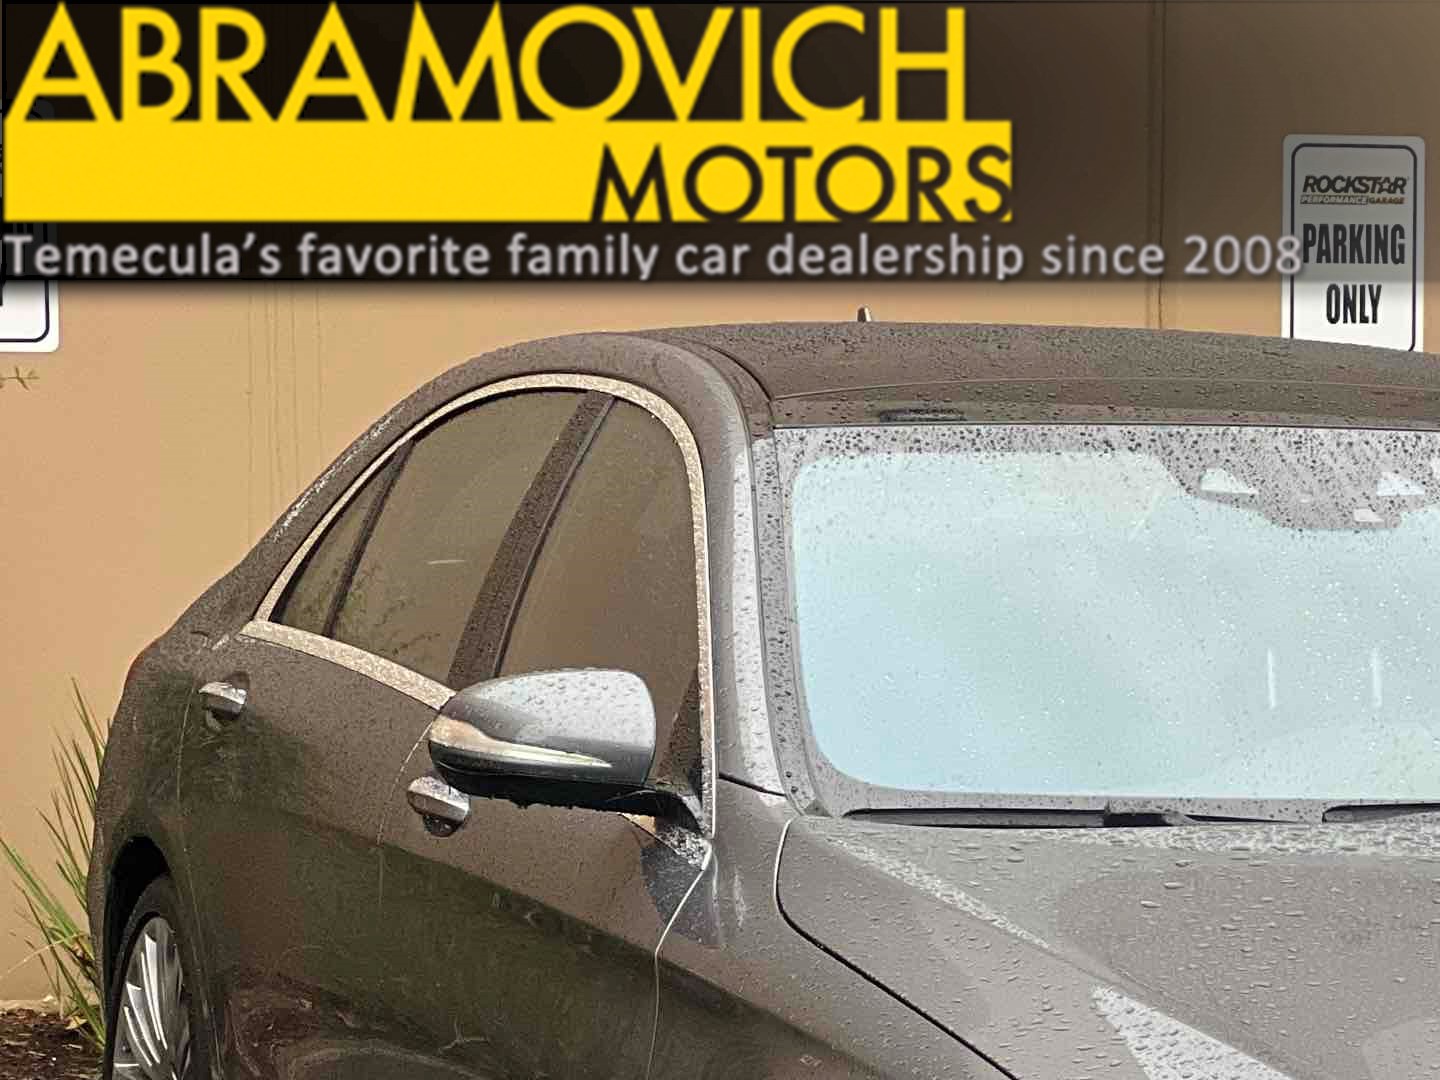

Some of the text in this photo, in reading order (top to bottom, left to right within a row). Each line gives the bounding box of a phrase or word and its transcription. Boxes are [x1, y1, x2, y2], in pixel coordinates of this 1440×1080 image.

[1303, 175, 1407, 194] ROCKSTAR
[1303, 223, 1405, 265] PARKING
[1326, 283, 1382, 325] ONLY
